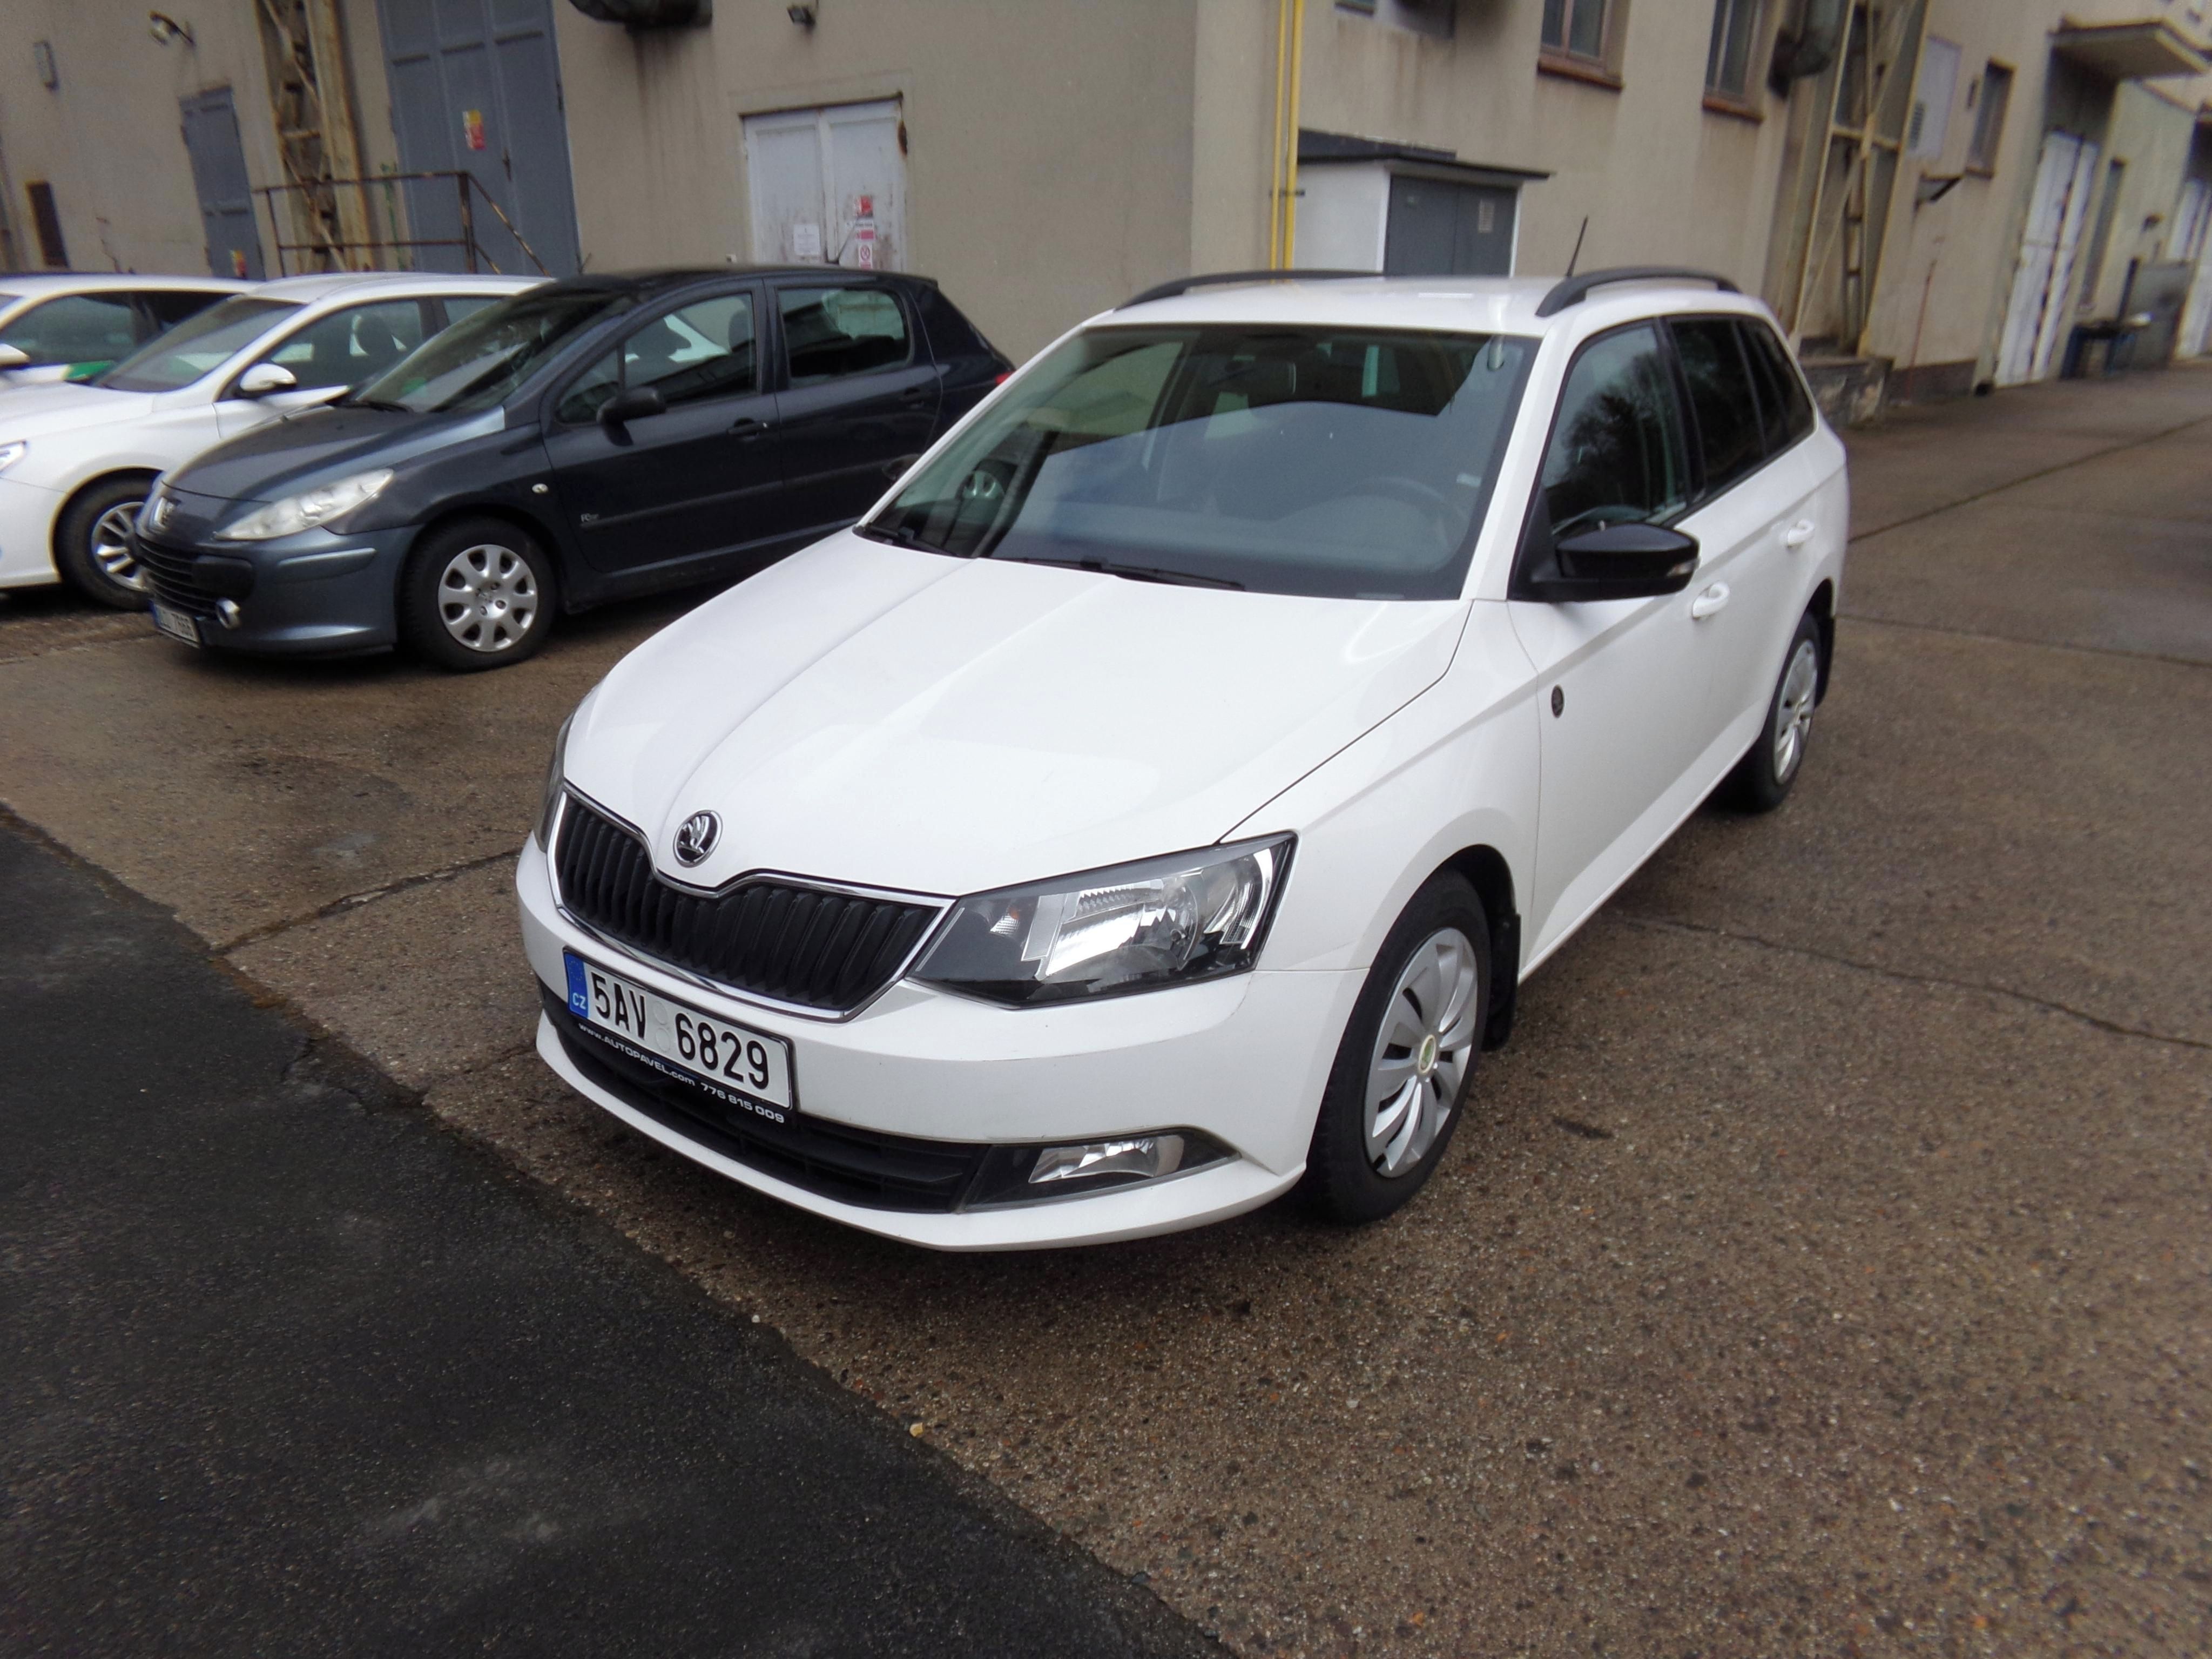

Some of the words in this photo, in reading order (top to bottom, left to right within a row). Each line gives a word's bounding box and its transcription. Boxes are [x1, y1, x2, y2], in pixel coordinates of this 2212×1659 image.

[572, 993, 586, 1009] CZ
[591, 972, 646, 1040] 5AV
[676, 1013, 769, 1090] 6829
[578, 1023, 696, 1086] www.AUTOPAVEL.com
[700, 1082, 726, 1100] 776
[728, 1094, 753, 1111] 815
[755, 1105, 785, 1123] 009
